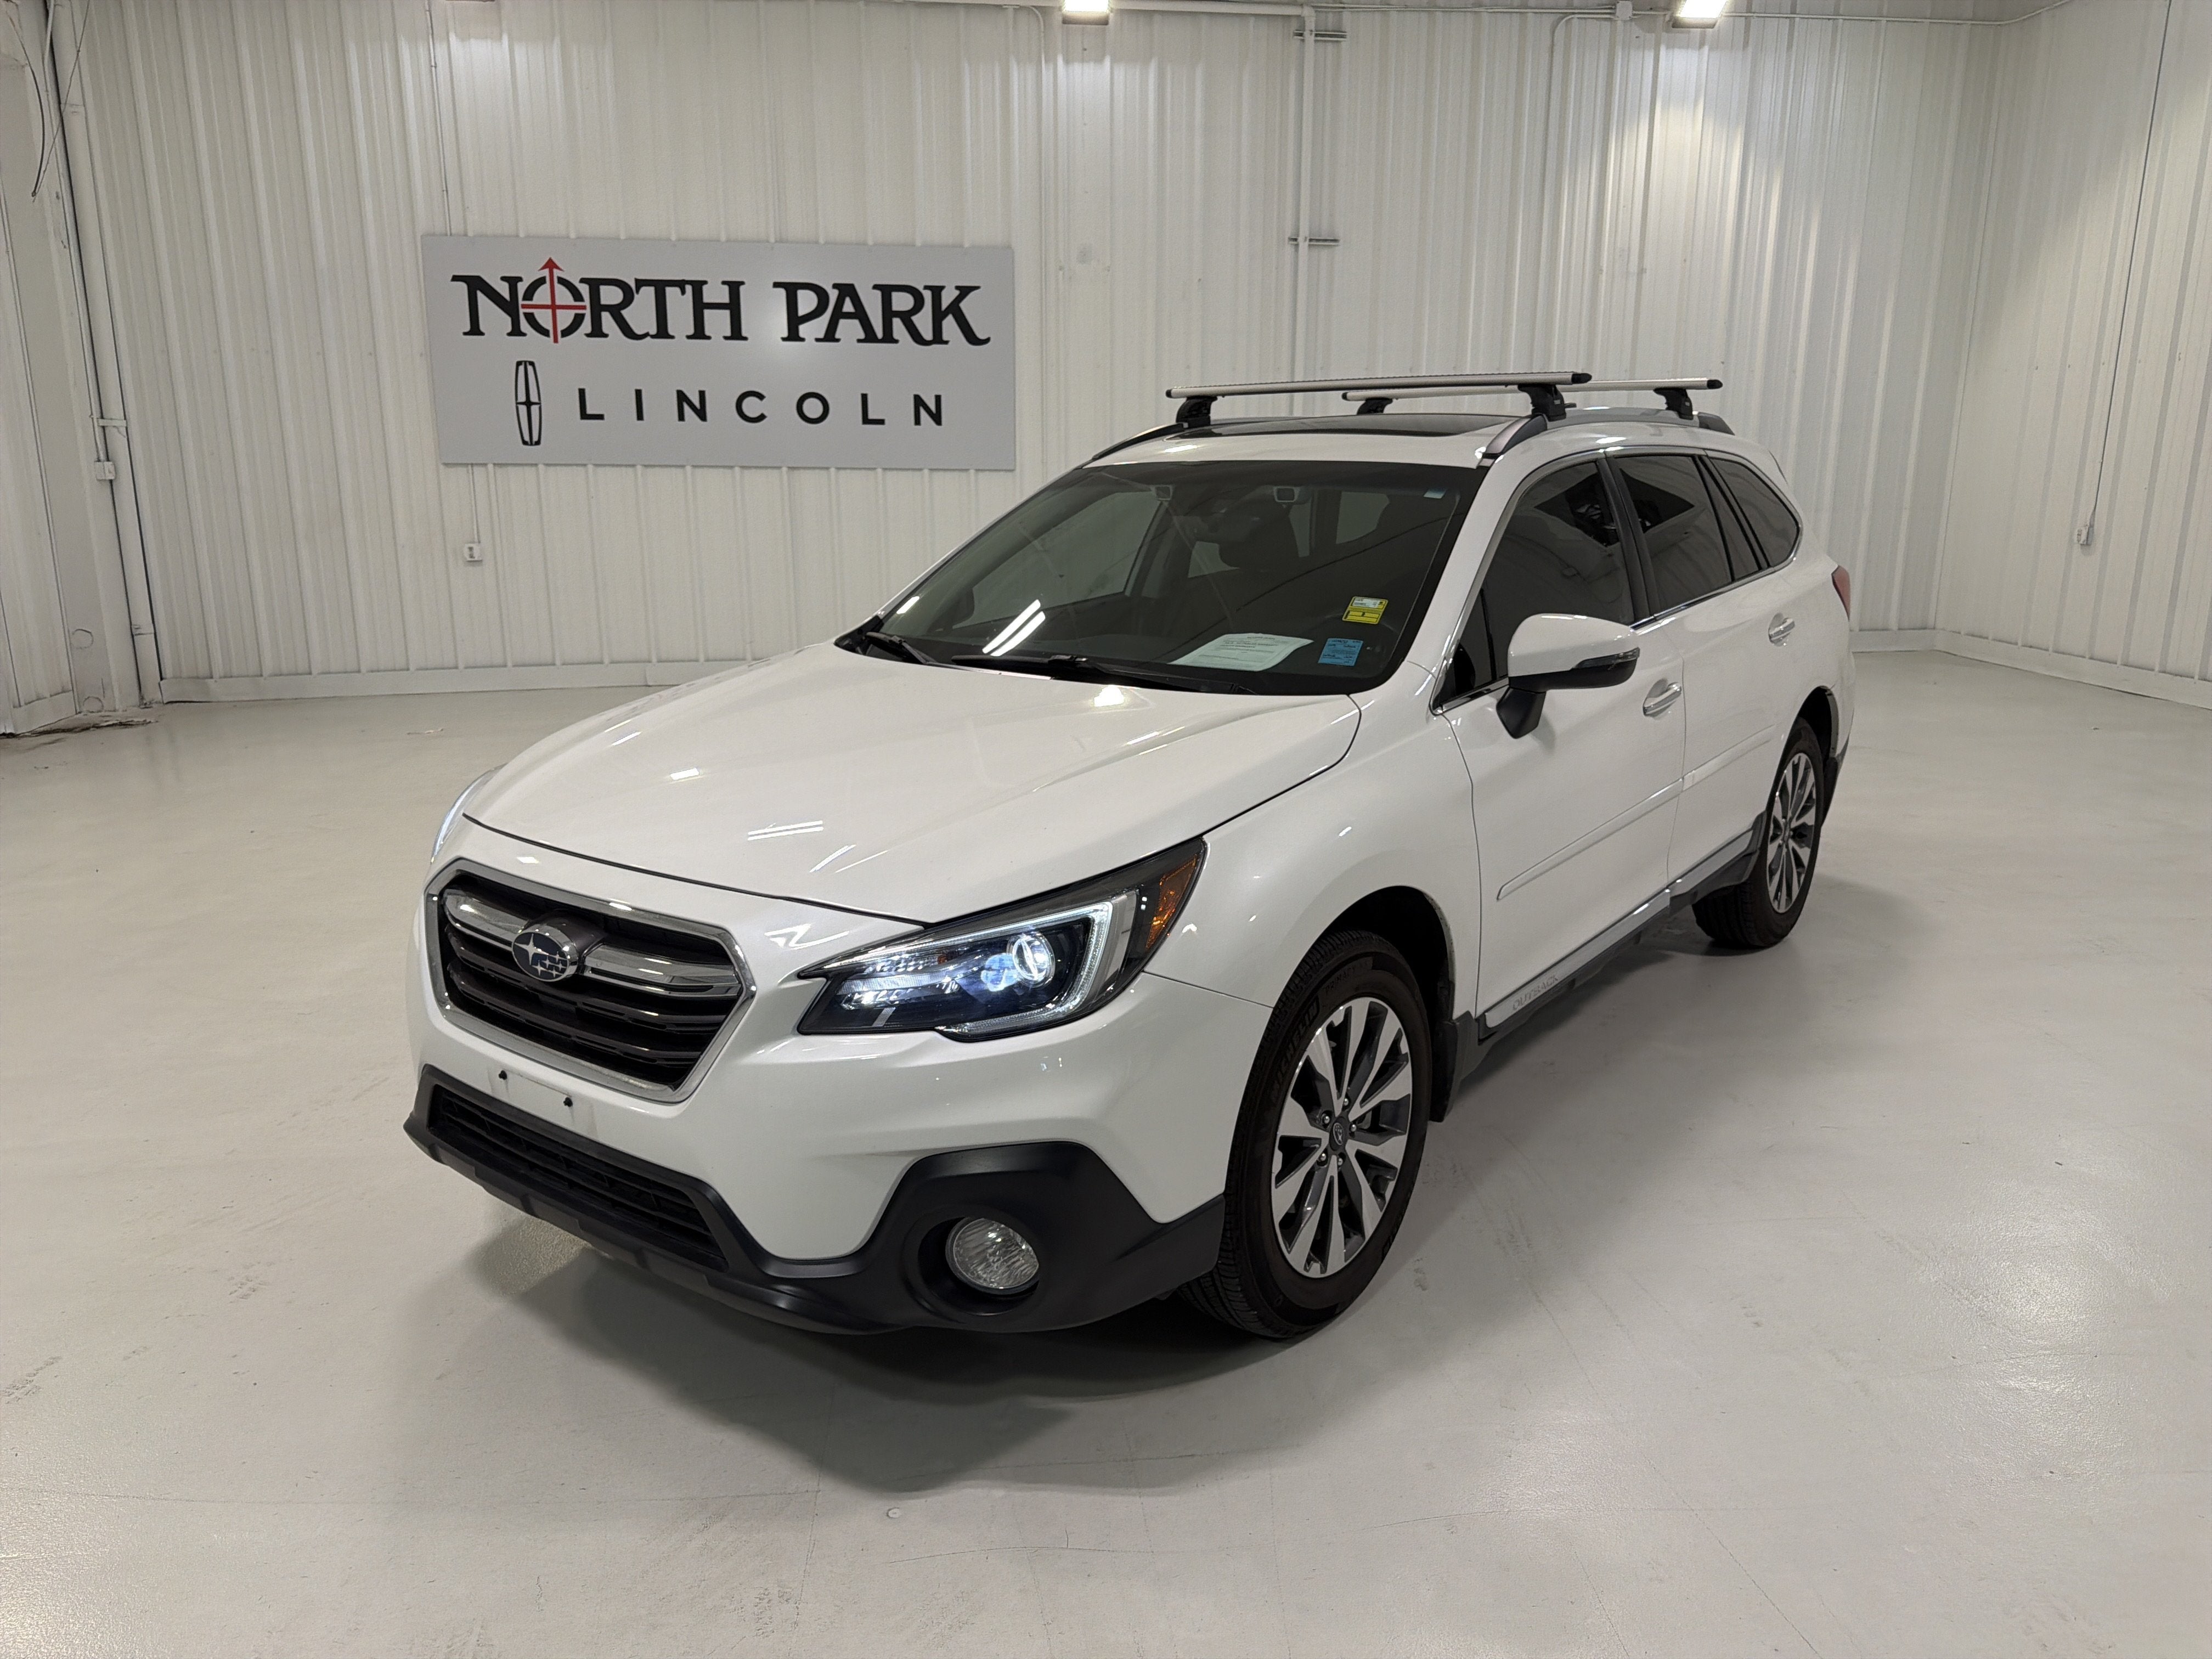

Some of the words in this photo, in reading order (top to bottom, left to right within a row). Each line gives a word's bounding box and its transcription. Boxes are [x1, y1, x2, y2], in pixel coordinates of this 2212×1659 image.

[451, 274, 748, 341] NORTH
[773, 281, 991, 346] PARK
[578, 387, 944, 426] LINCOLN
[1269, 997, 1319, 1105] MICHELIN
